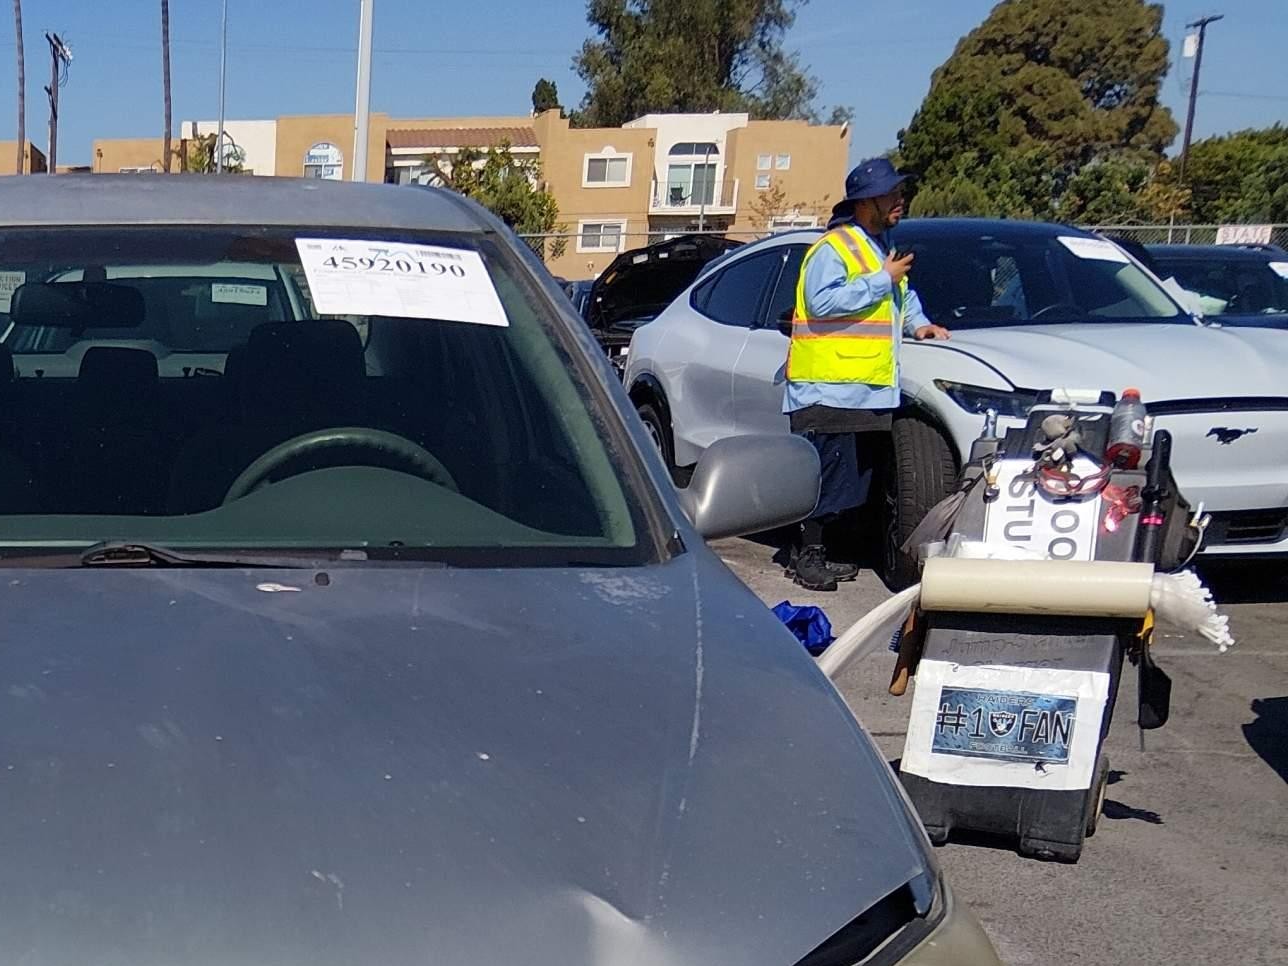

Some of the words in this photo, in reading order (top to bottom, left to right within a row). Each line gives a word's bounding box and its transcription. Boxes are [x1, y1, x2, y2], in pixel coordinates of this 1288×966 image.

[322, 255, 466, 278] 45920190
[1003, 474, 1035, 542] STU
[936, 703, 986, 739] #1
[1018, 709, 1072, 748] FAN
